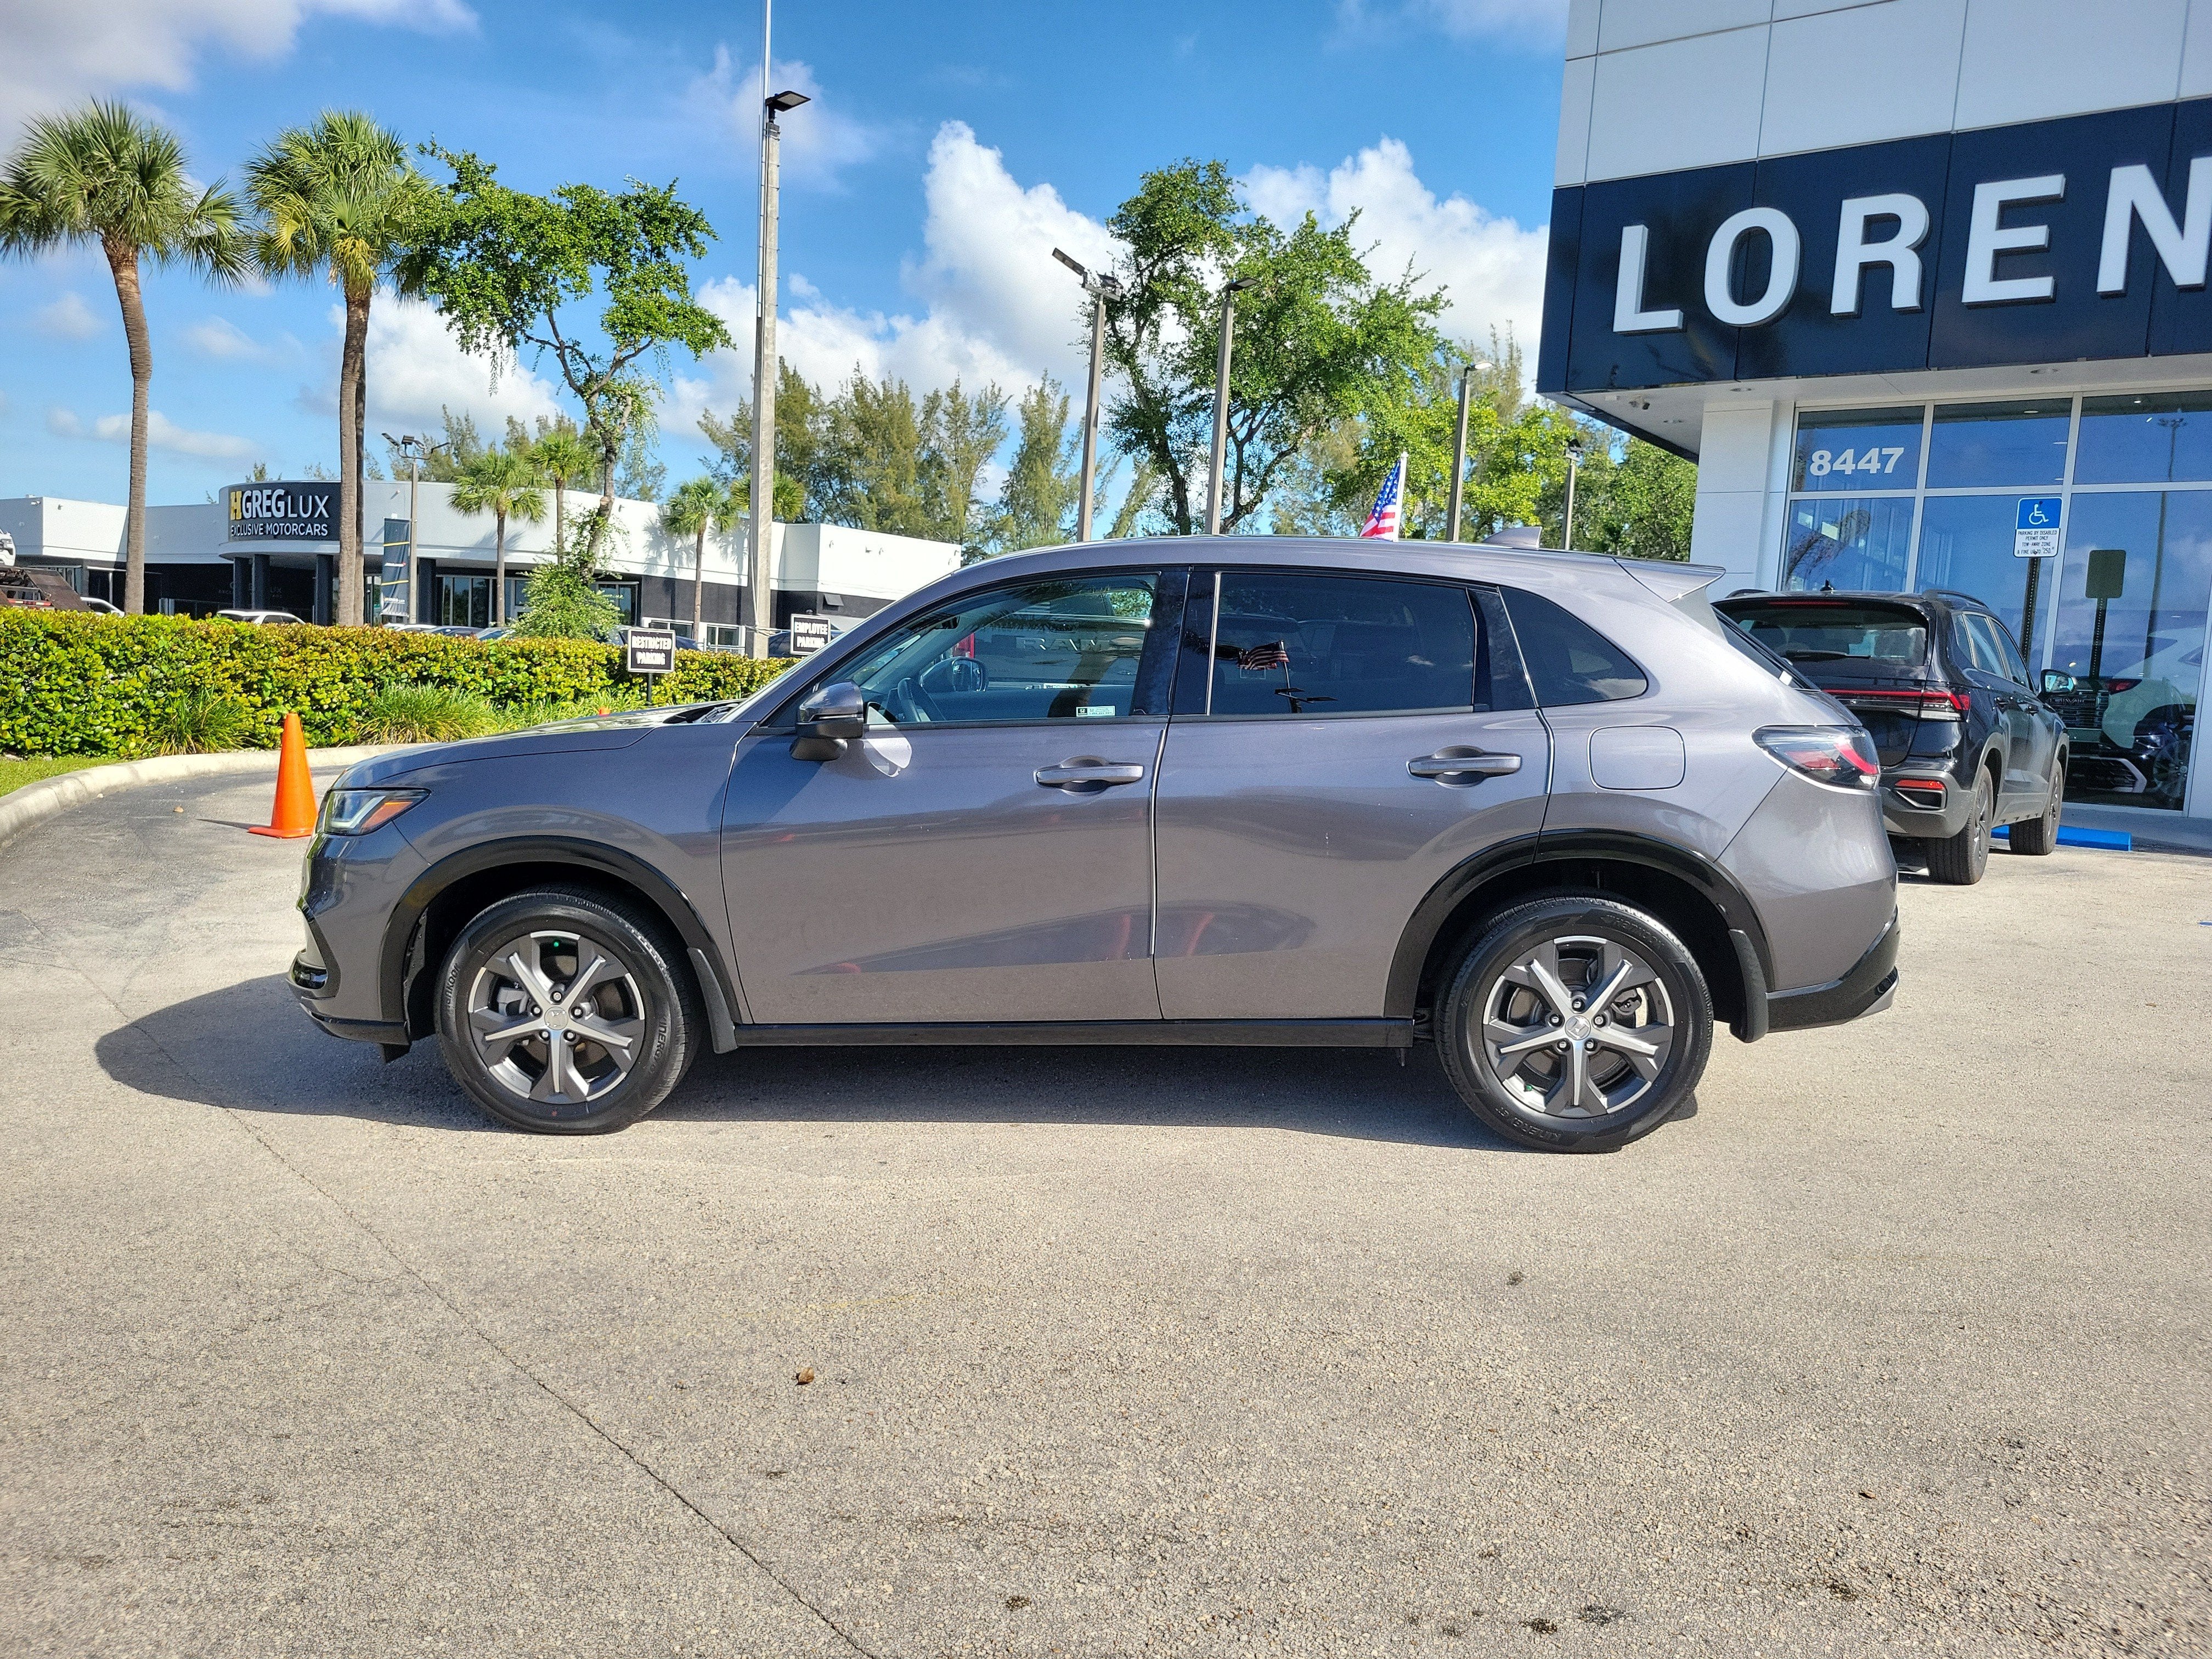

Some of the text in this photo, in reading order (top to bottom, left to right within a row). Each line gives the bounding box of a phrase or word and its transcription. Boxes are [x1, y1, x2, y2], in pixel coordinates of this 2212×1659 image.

[1612, 156, 2212, 334] LOREN
[1810, 447, 1904, 476] 8447
[230, 523, 328, 537] EXCLUSIVE MOTORCARS
[794, 622, 828, 635] EMPLOYEE
[632, 636, 672, 650] RESTRICTED
[797, 636, 825, 648] PARKING
[636, 652, 665, 665] PARKING
